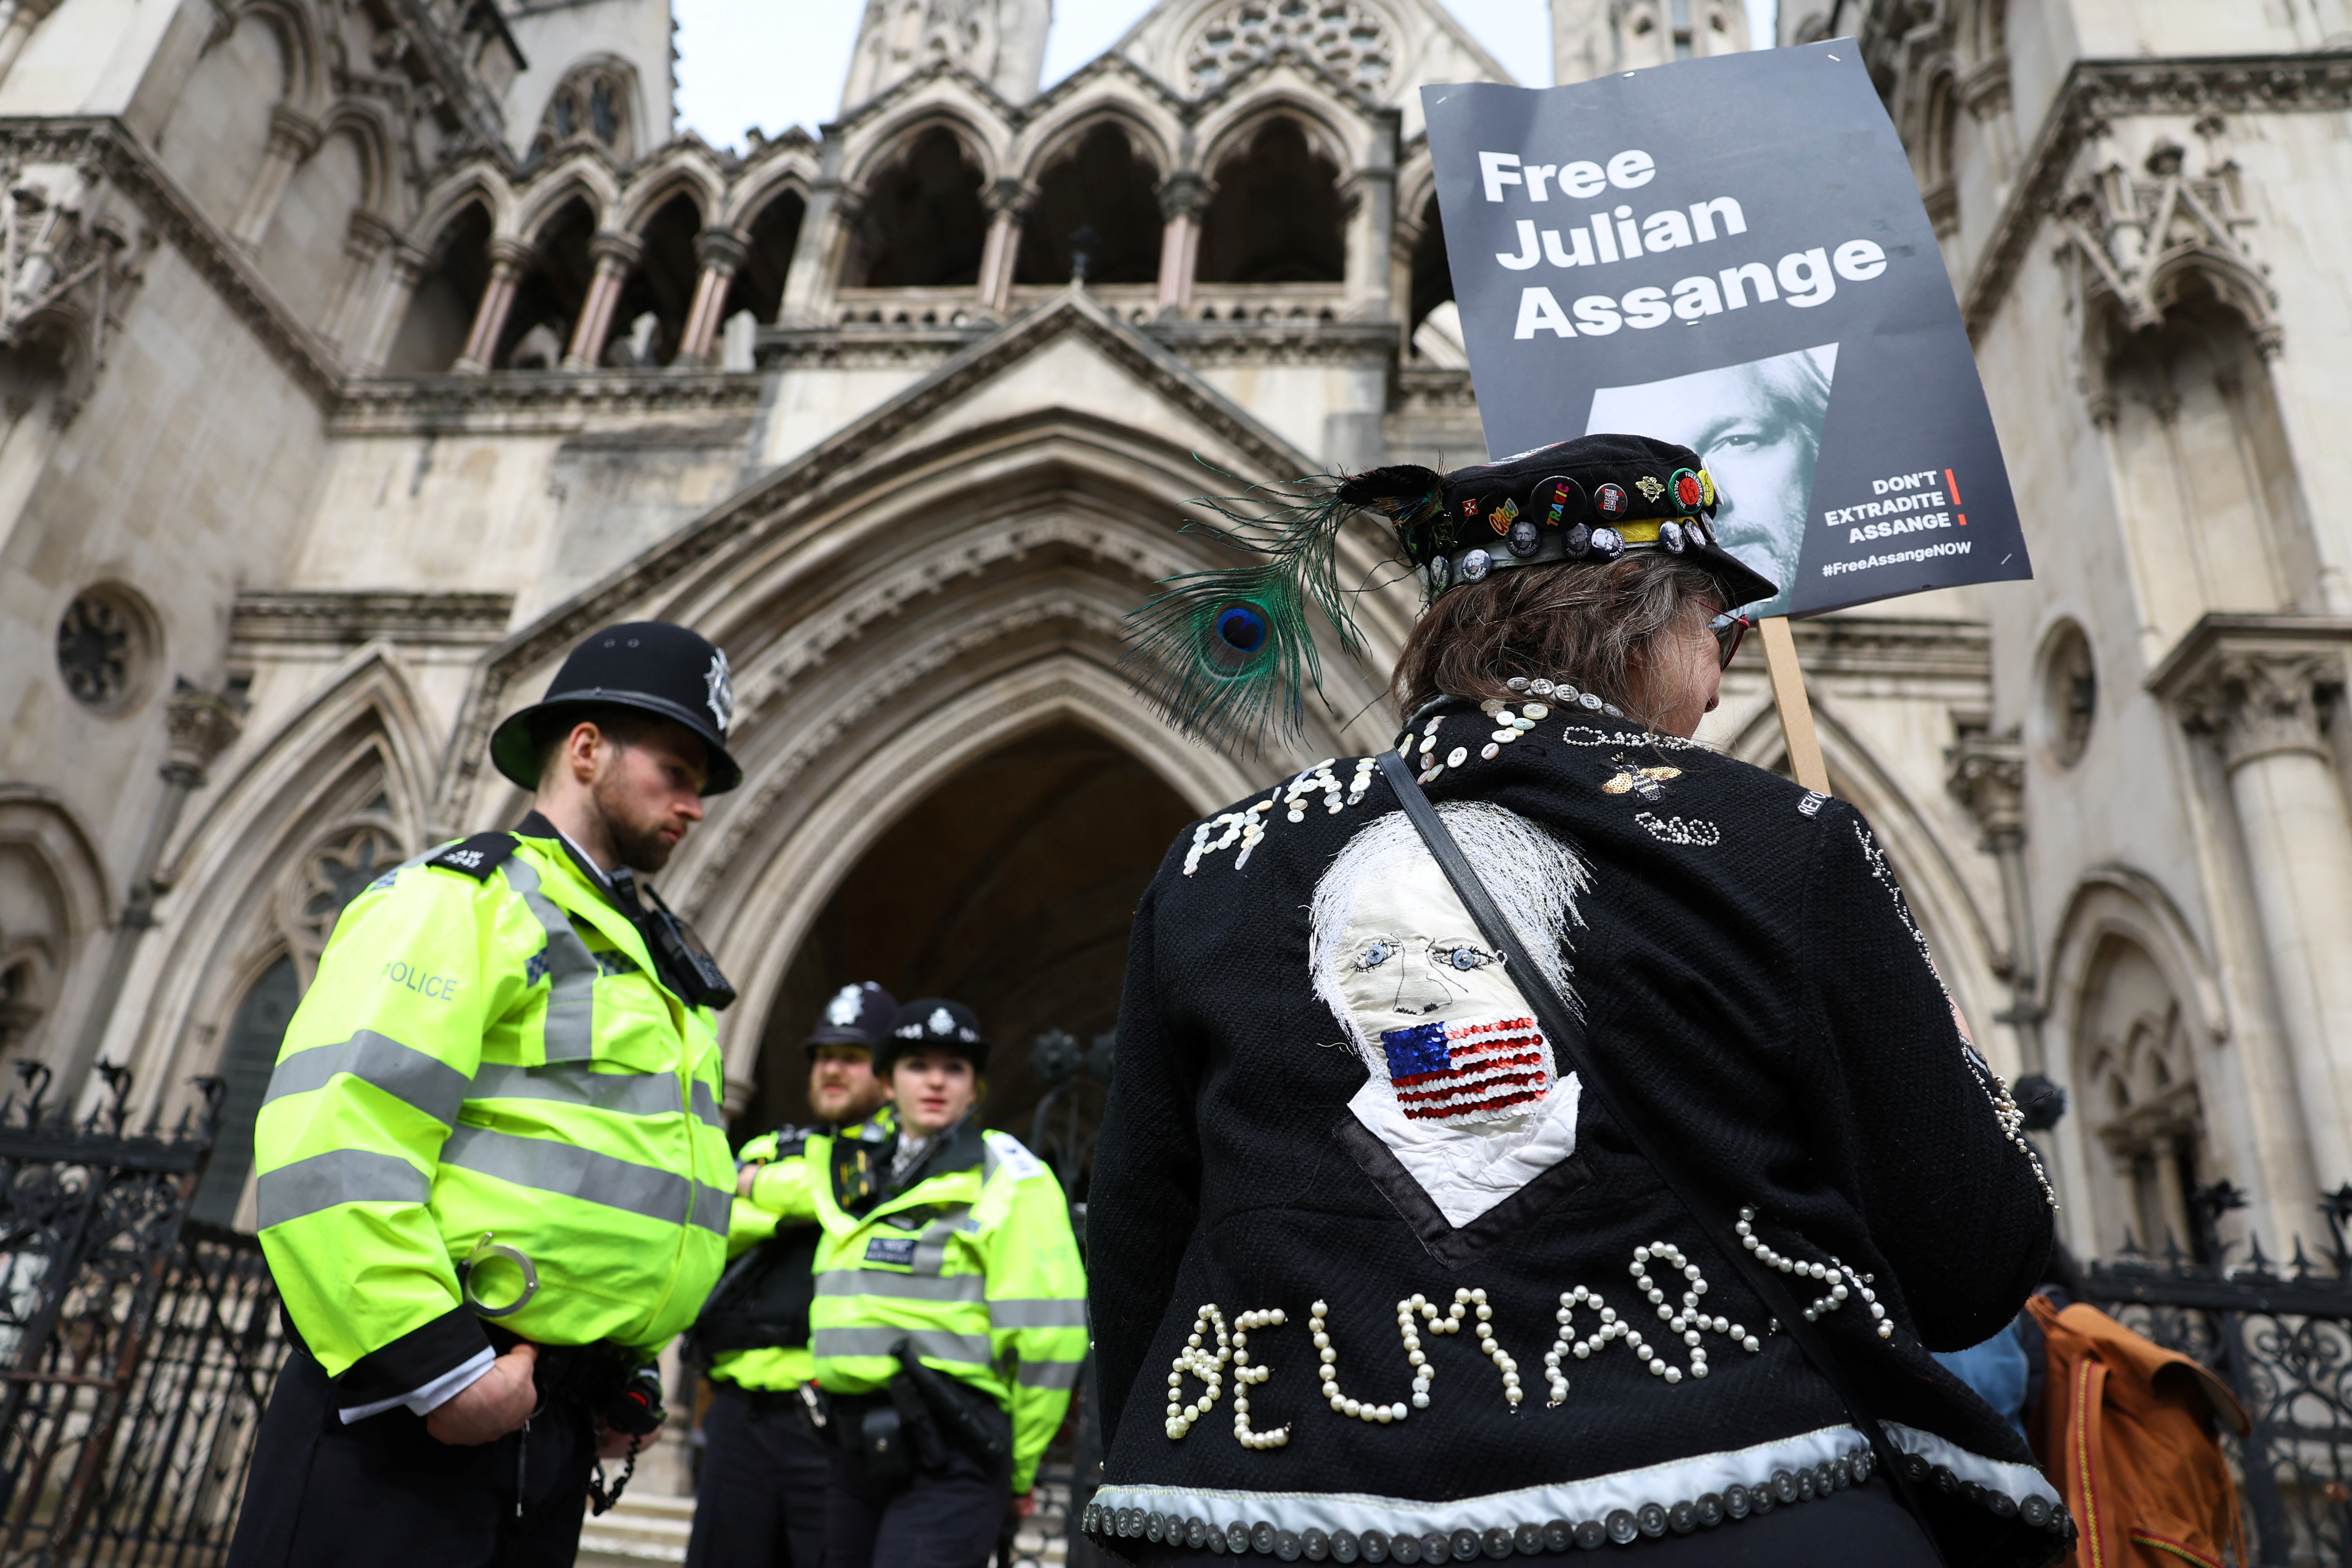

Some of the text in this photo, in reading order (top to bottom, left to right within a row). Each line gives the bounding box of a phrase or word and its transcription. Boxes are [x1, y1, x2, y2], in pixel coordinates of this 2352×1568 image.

[1479, 149, 1656, 202] Free
[1496, 196, 1748, 270] Julian
[1514, 239, 1887, 339] Assange
[1674, 480, 1686, 509] PALESTINE
[1685, 472, 1703, 493] FREEDOM
[1873, 470, 1937, 495] DON'T
[1546, 483, 1569, 526] TRAGIC
[1824, 491, 1945, 526] EXTRADITE
[1510, 541, 1518, 552] FREE
[1517, 544, 1538, 554] ASSANGE
[1566, 541, 1592, 556] FREE ASSANGE
[1615, 532, 1623, 552] ASSANGE
[1666, 541, 1675, 551] FREE
[1822, 541, 1971, 577] #FreeAssangeNOW
[1470, 567, 1486, 579] ASSANGE
